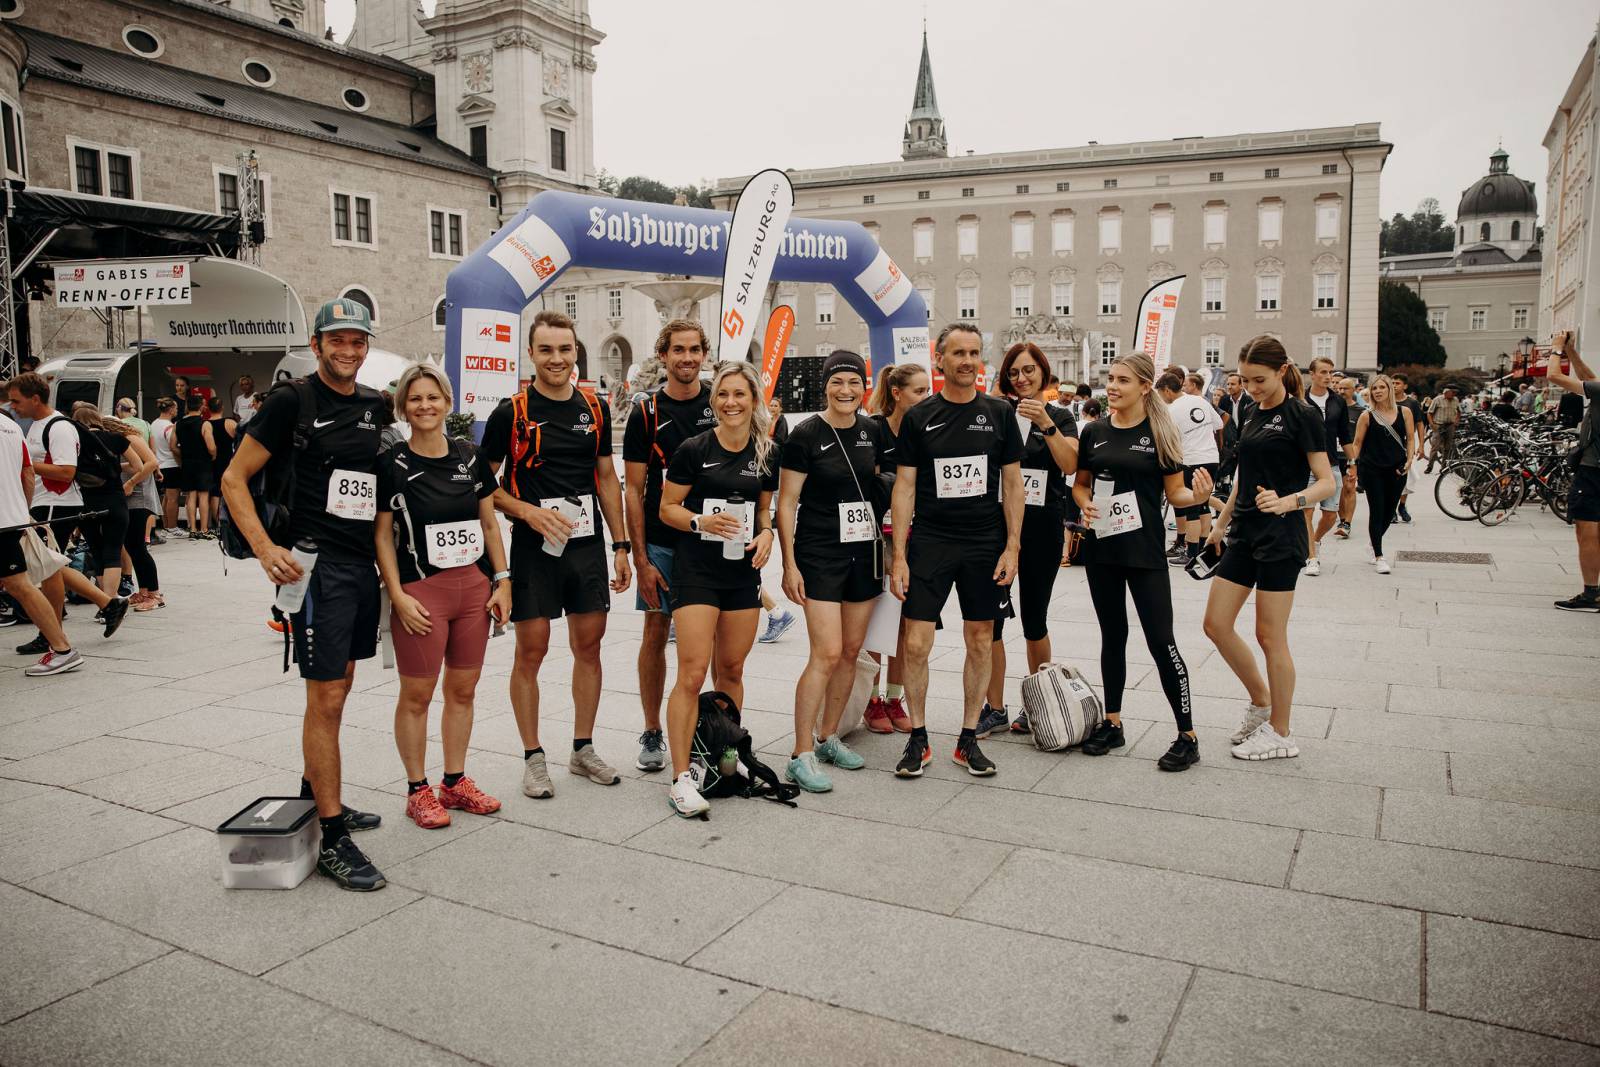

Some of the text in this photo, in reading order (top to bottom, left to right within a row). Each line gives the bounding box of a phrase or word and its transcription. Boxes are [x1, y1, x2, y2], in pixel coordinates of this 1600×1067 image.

[587, 206, 721, 256] Salzburger
[736, 183, 779, 305] SALZBURG AG
[97, 268, 148, 280] GABIS
[59, 286, 190, 302] RENN-OFFICE
[169, 320, 227, 338] Salzburger
[479, 327, 493, 337] AK
[1145, 319, 1160, 362] AMMER
[768, 319, 788, 371] SALZBURG
[466, 358, 505, 370] WKS
[1168, 644, 1190, 714] OCEANS APART
